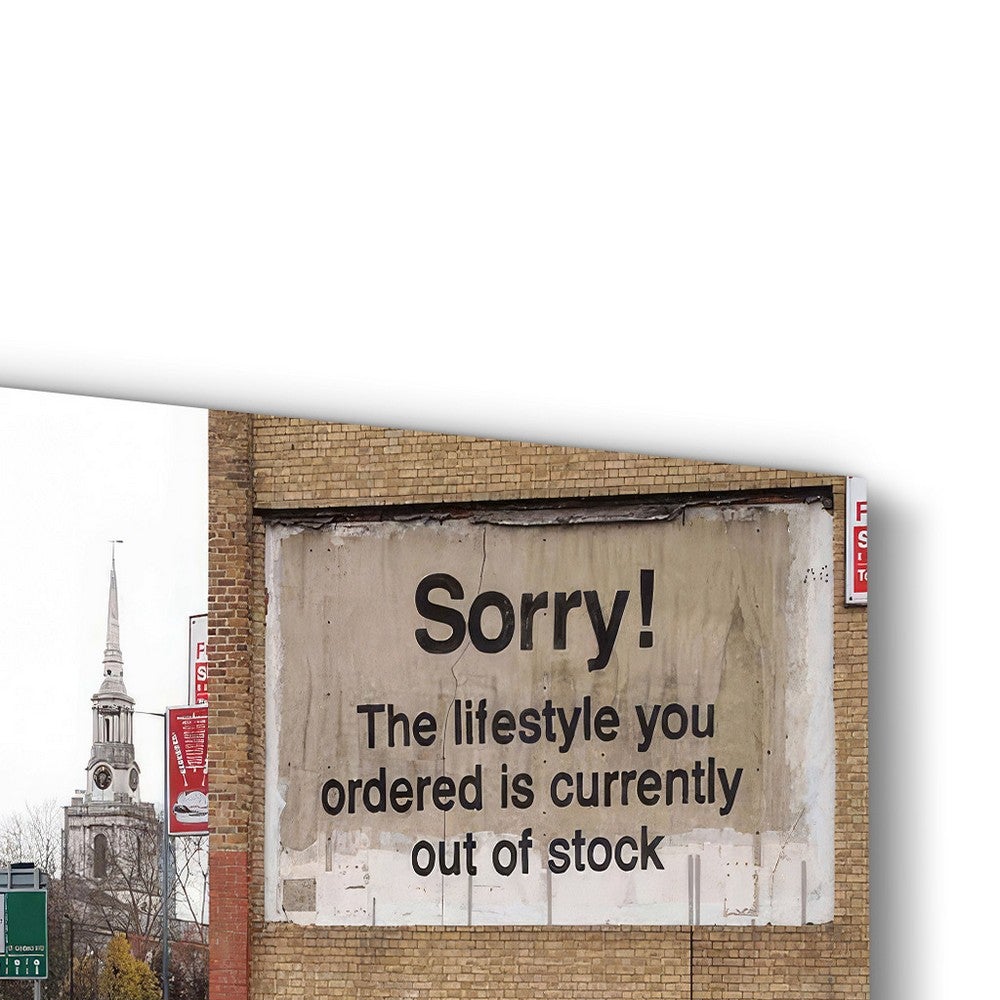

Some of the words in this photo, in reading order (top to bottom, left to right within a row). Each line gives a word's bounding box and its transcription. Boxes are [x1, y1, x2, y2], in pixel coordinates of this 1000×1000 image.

[413, 567, 656, 673] Sorry!
[355, 702, 438, 750] The
[453, 694, 621, 754] lifestyle
[634, 702, 716, 754] you
[320, 764, 484, 817] ordered
[499, 763, 536, 810] is
[549, 755, 745, 818] currently
[410, 831, 478, 878] out
[491, 827, 534, 878] of
[546, 825, 666, 875] stock
